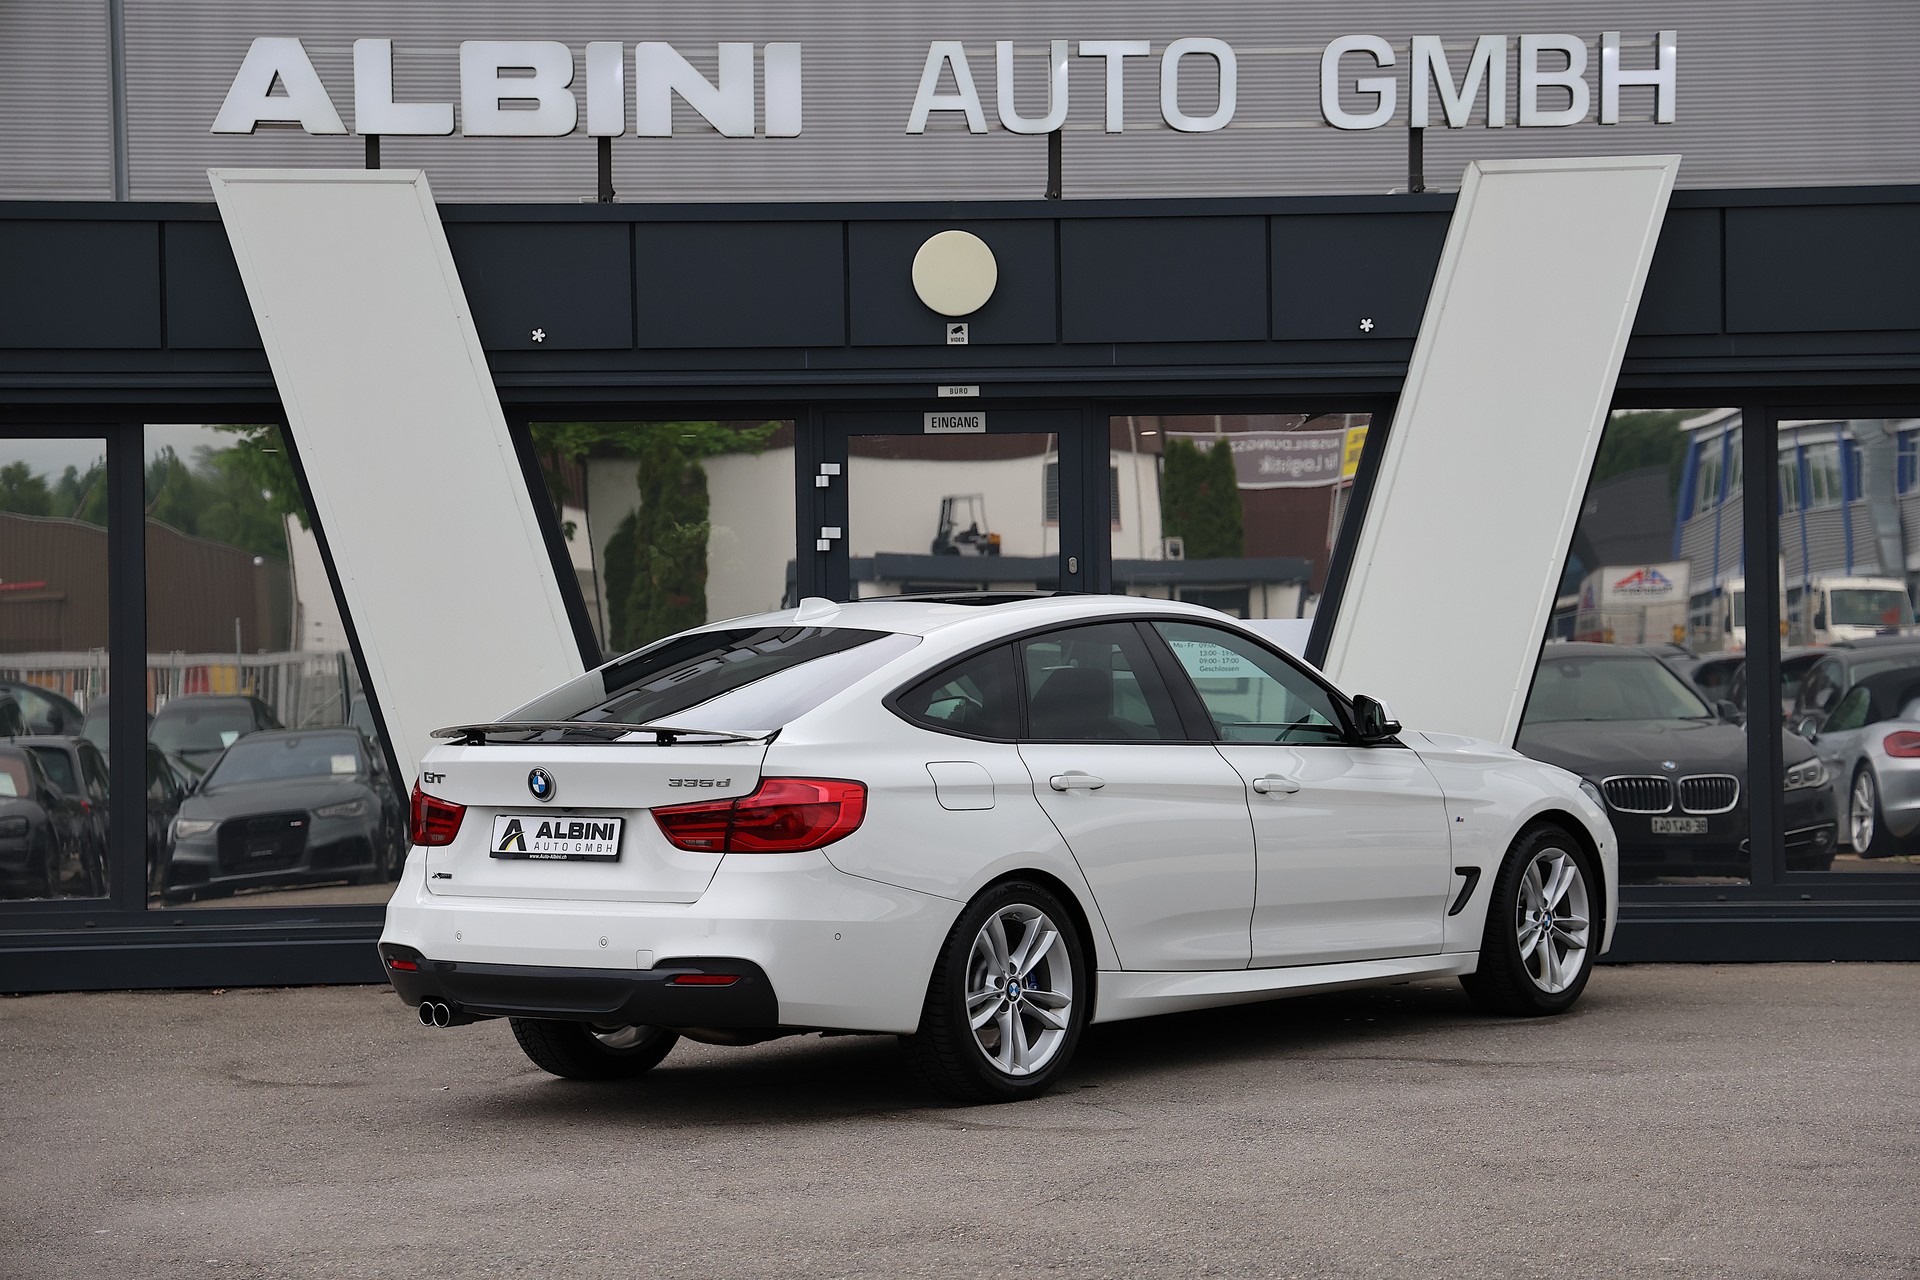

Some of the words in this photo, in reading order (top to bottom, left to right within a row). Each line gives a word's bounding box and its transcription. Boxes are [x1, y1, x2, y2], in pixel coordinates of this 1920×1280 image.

[209, 37, 802, 138] ALBINI
[905, 37, 1238, 136] AUTO
[1320, 30, 1678, 131] GMBH
[949, 387, 969, 395] BÜRO
[931, 416, 979, 428] EINGANG
[424, 772, 446, 784] GT
[668, 778, 731, 788] 335d
[535, 821, 616, 841] ALBINI
[533, 842, 569, 852] AUTO
[575, 843, 613, 853] GMBH
